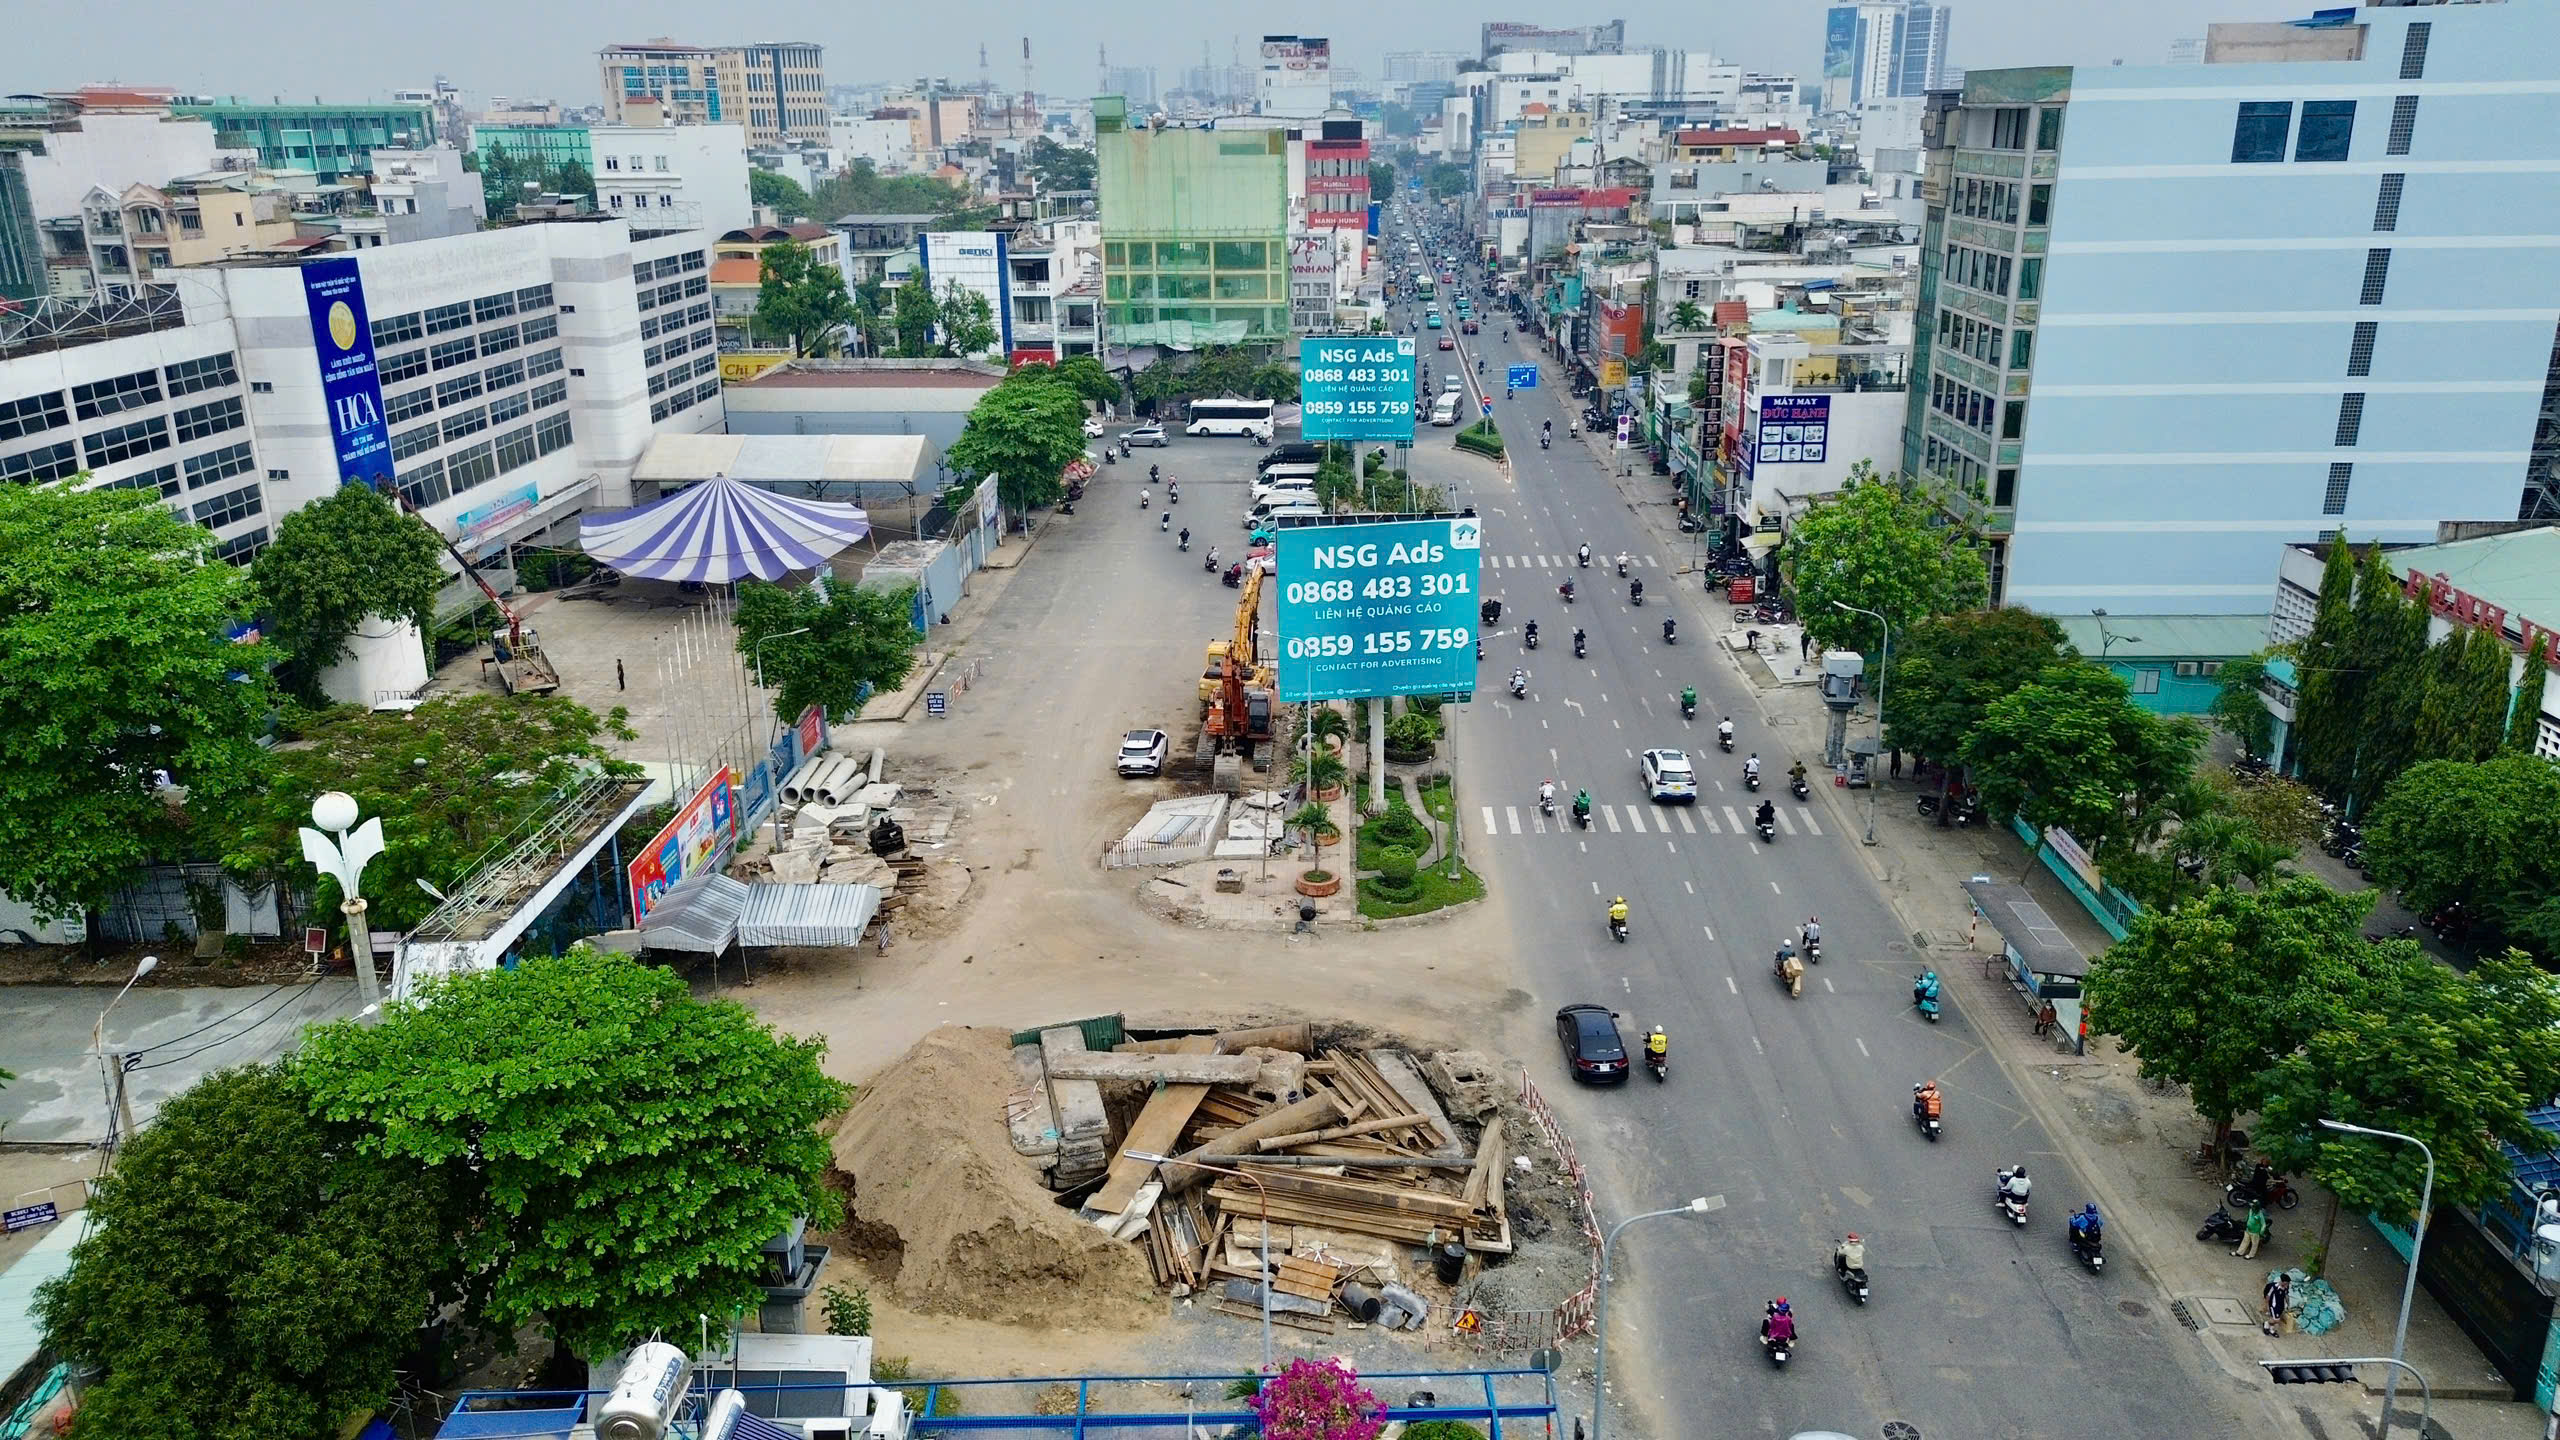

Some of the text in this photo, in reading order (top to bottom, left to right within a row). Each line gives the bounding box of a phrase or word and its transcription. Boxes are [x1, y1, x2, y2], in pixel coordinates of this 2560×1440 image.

[1510, 208, 1528, 218] KHOA
[1320, 348, 1395, 363] NSG Ads
[725, 364, 748, 376] Chi
[1304, 369, 1409, 382] 0868 483 301
[1305, 401, 1409, 414] 0859 155 759
[1773, 397, 1795, 405] MÁY
[334, 390, 380, 433] HCA
[1314, 540, 1444, 569] NSG Ads
[1287, 573, 1470, 604] 0868 483 301
[1315, 602, 1442, 620] LIÊN HỆ QUẢNG CÁO
[1287, 627, 1469, 659] 0859 155 759
[1316, 657, 1442, 672] CONTACT FOR ADVERTISING
